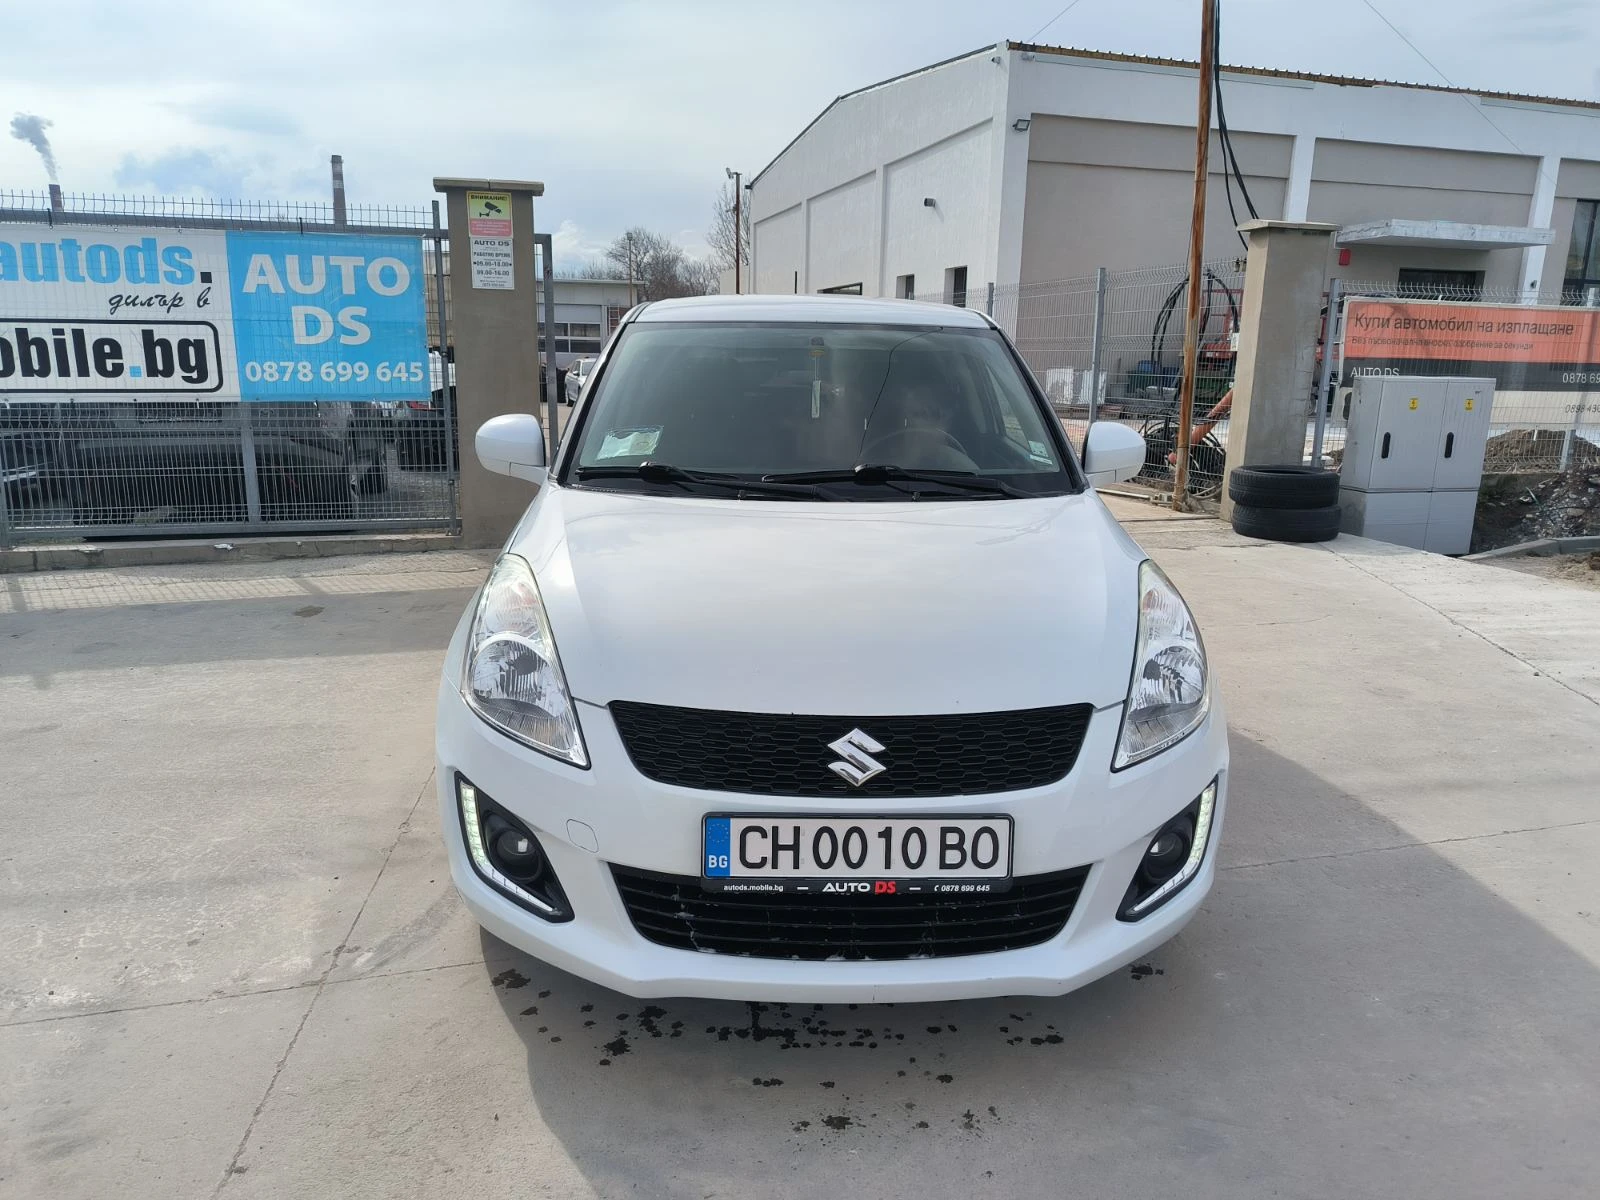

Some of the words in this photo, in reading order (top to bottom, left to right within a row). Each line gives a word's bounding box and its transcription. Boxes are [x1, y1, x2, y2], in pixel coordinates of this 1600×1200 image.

[242, 254, 411, 296] AUTO
[108, 292, 185, 315] дилър
[196, 286, 212, 308] в
[291, 305, 372, 345] DS
[1354, 313, 1390, 331] Купи
[1394, 316, 1473, 332] автомобил
[1477, 321, 1493, 333] на
[1497, 322, 1574, 336] изплащане
[245, 361, 314, 382] 0878
[320, 361, 370, 382] 699
[376, 361, 424, 382] 645
[1350, 367, 1381, 377] AUTO
[1562, 372, 1587, 384] 0878
[739, 826, 801, 870] CH
[812, 826, 927, 870] 0010
[708, 856, 728, 868] BG
[723, 884, 784, 893] autods.mobile.bg
[822, 882, 871, 893] AUTO
[874, 881, 897, 894] DS
[976, 884, 990, 892] 645
